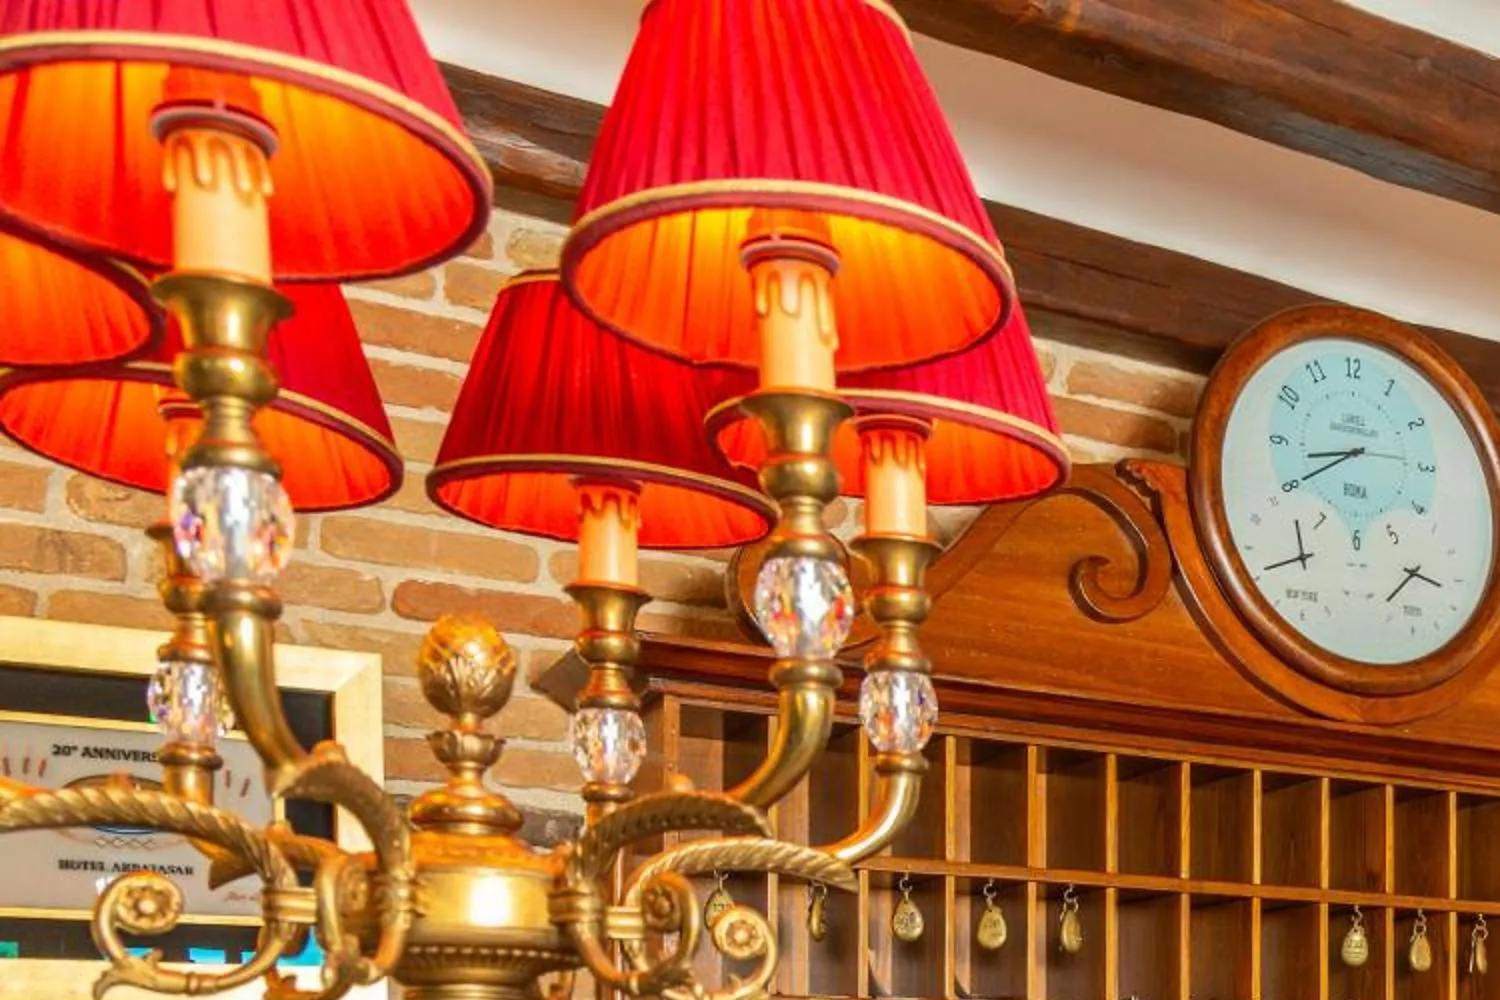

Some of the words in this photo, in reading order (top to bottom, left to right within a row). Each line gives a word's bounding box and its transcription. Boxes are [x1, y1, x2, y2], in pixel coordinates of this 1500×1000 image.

[1305, 360, 1327, 384] 11
[1345, 357, 1361, 380] 12
[1384, 379, 1395, 397] 1
[1277, 385, 1300, 410] 10
[1408, 417, 1425, 430] 2
[1269, 434, 1289, 446] 9
[1417, 462, 1436, 473] 3
[1281, 479, 1299, 492] 8
[1411, 501, 1426, 515] 4
[1313, 512, 1327, 529] 7
[1352, 529, 1361, 551] 6
[1386, 524, 1399, 545] 5
[58, 859, 105, 872] HOTEL
